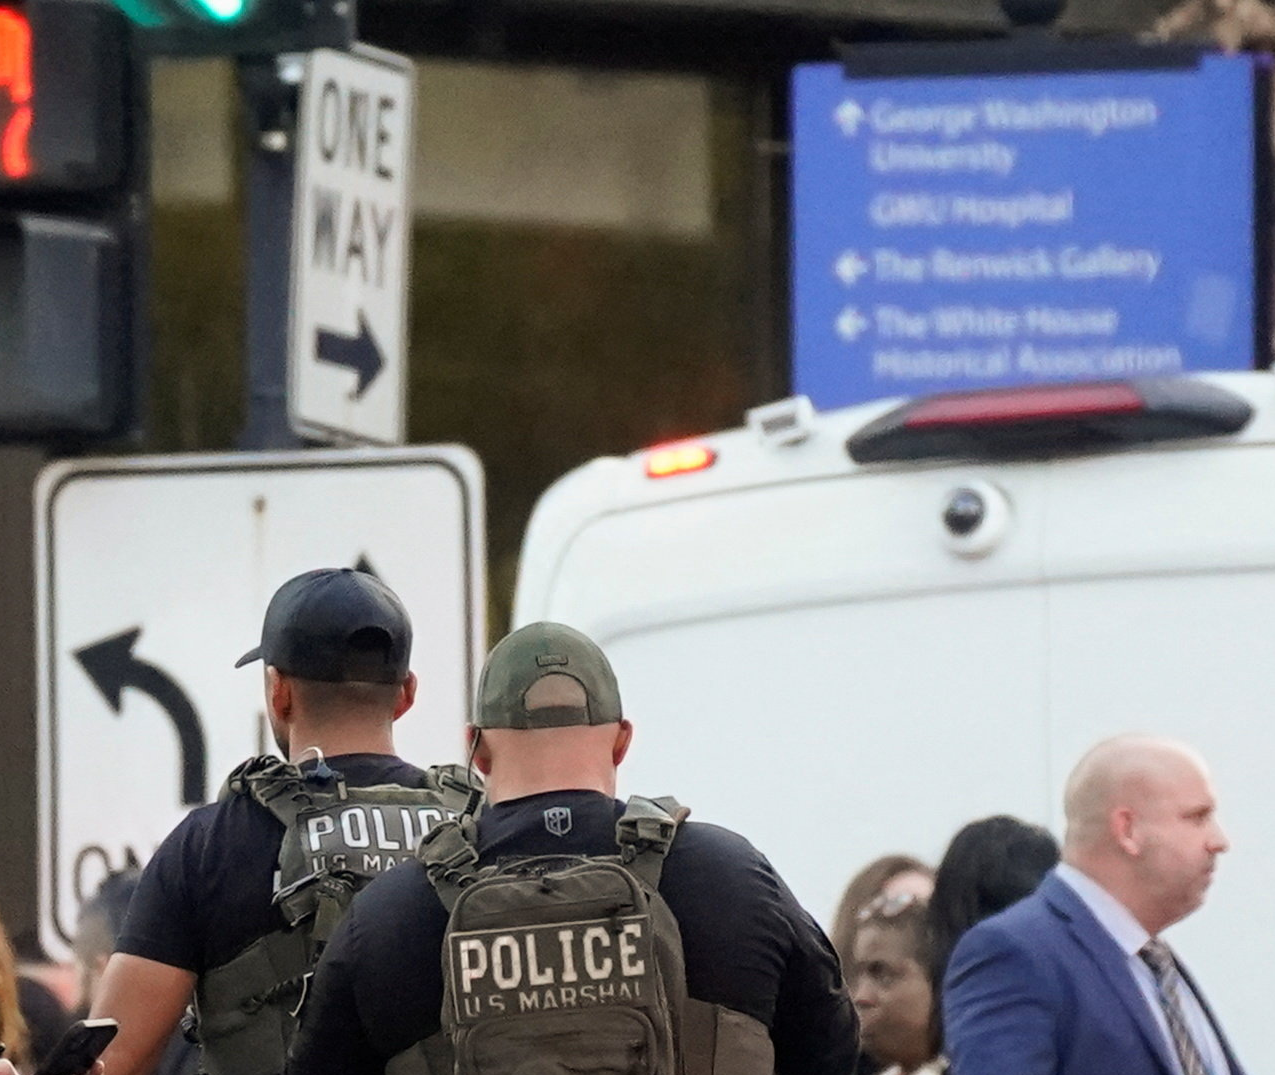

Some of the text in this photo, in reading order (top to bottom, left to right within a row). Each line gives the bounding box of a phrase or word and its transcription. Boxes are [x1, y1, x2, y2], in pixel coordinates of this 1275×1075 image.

[318, 77, 396, 180] ONE
[870, 97, 1158, 138] George Washington
[870, 142, 1015, 176] University
[952, 188, 1073, 228] Hospital
[312, 188, 394, 288] WAY
[875, 245, 1160, 283] The Renwick Gallery
[875, 303, 1118, 337] The White House
[873, 344, 1182, 378] Historical Association
[307, 807, 456, 852] POLIC
[460, 924, 645, 993] POLICE
